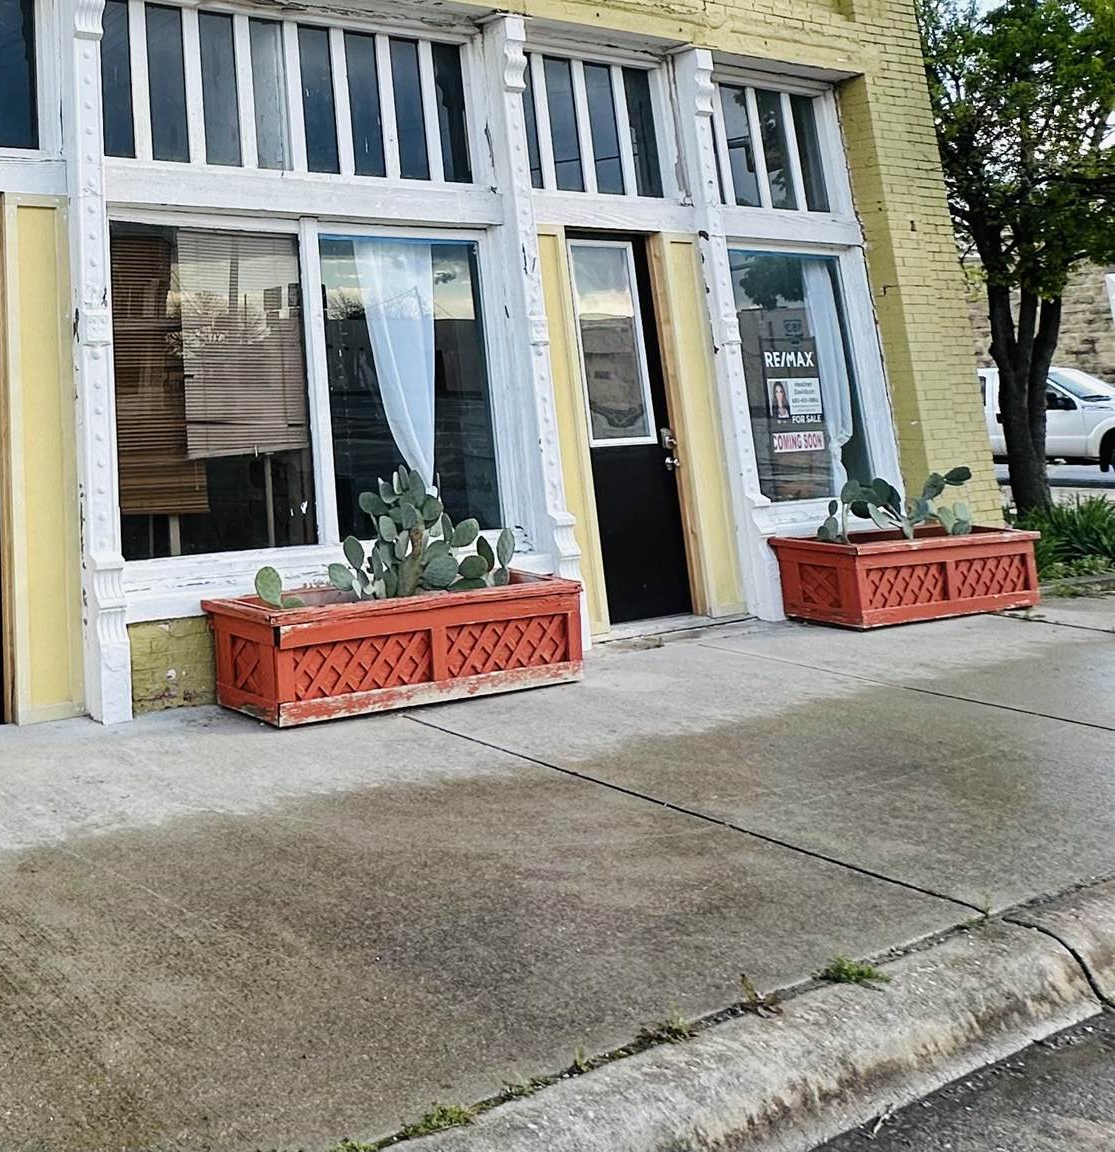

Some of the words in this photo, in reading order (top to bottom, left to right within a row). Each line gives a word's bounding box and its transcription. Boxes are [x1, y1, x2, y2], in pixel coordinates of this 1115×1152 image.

[763, 351, 814, 368] RE/MAX
[791, 414, 806, 424] FOR
[806, 414, 822, 423] SALE
[773, 433, 802, 450] COMING
[803, 433, 823, 449] SOON
